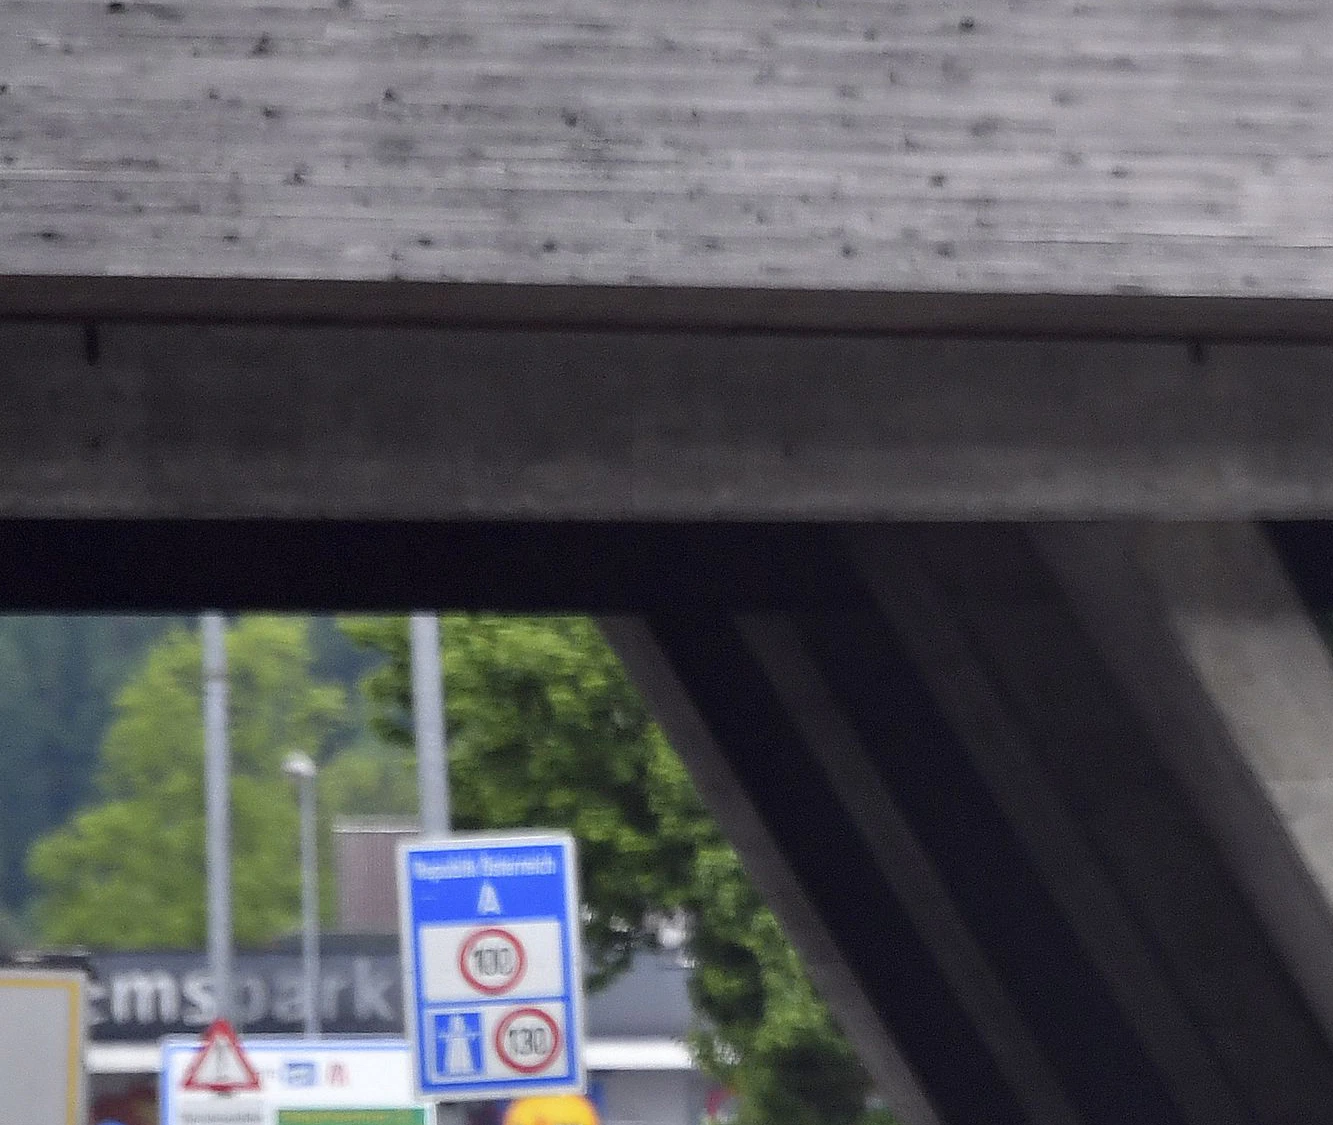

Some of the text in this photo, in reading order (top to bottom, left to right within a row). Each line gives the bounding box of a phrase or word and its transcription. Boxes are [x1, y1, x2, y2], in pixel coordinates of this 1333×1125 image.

[475, 879, 502, 915] A
[474, 947, 515, 977] 100
[508, 1026, 548, 1056] 130
